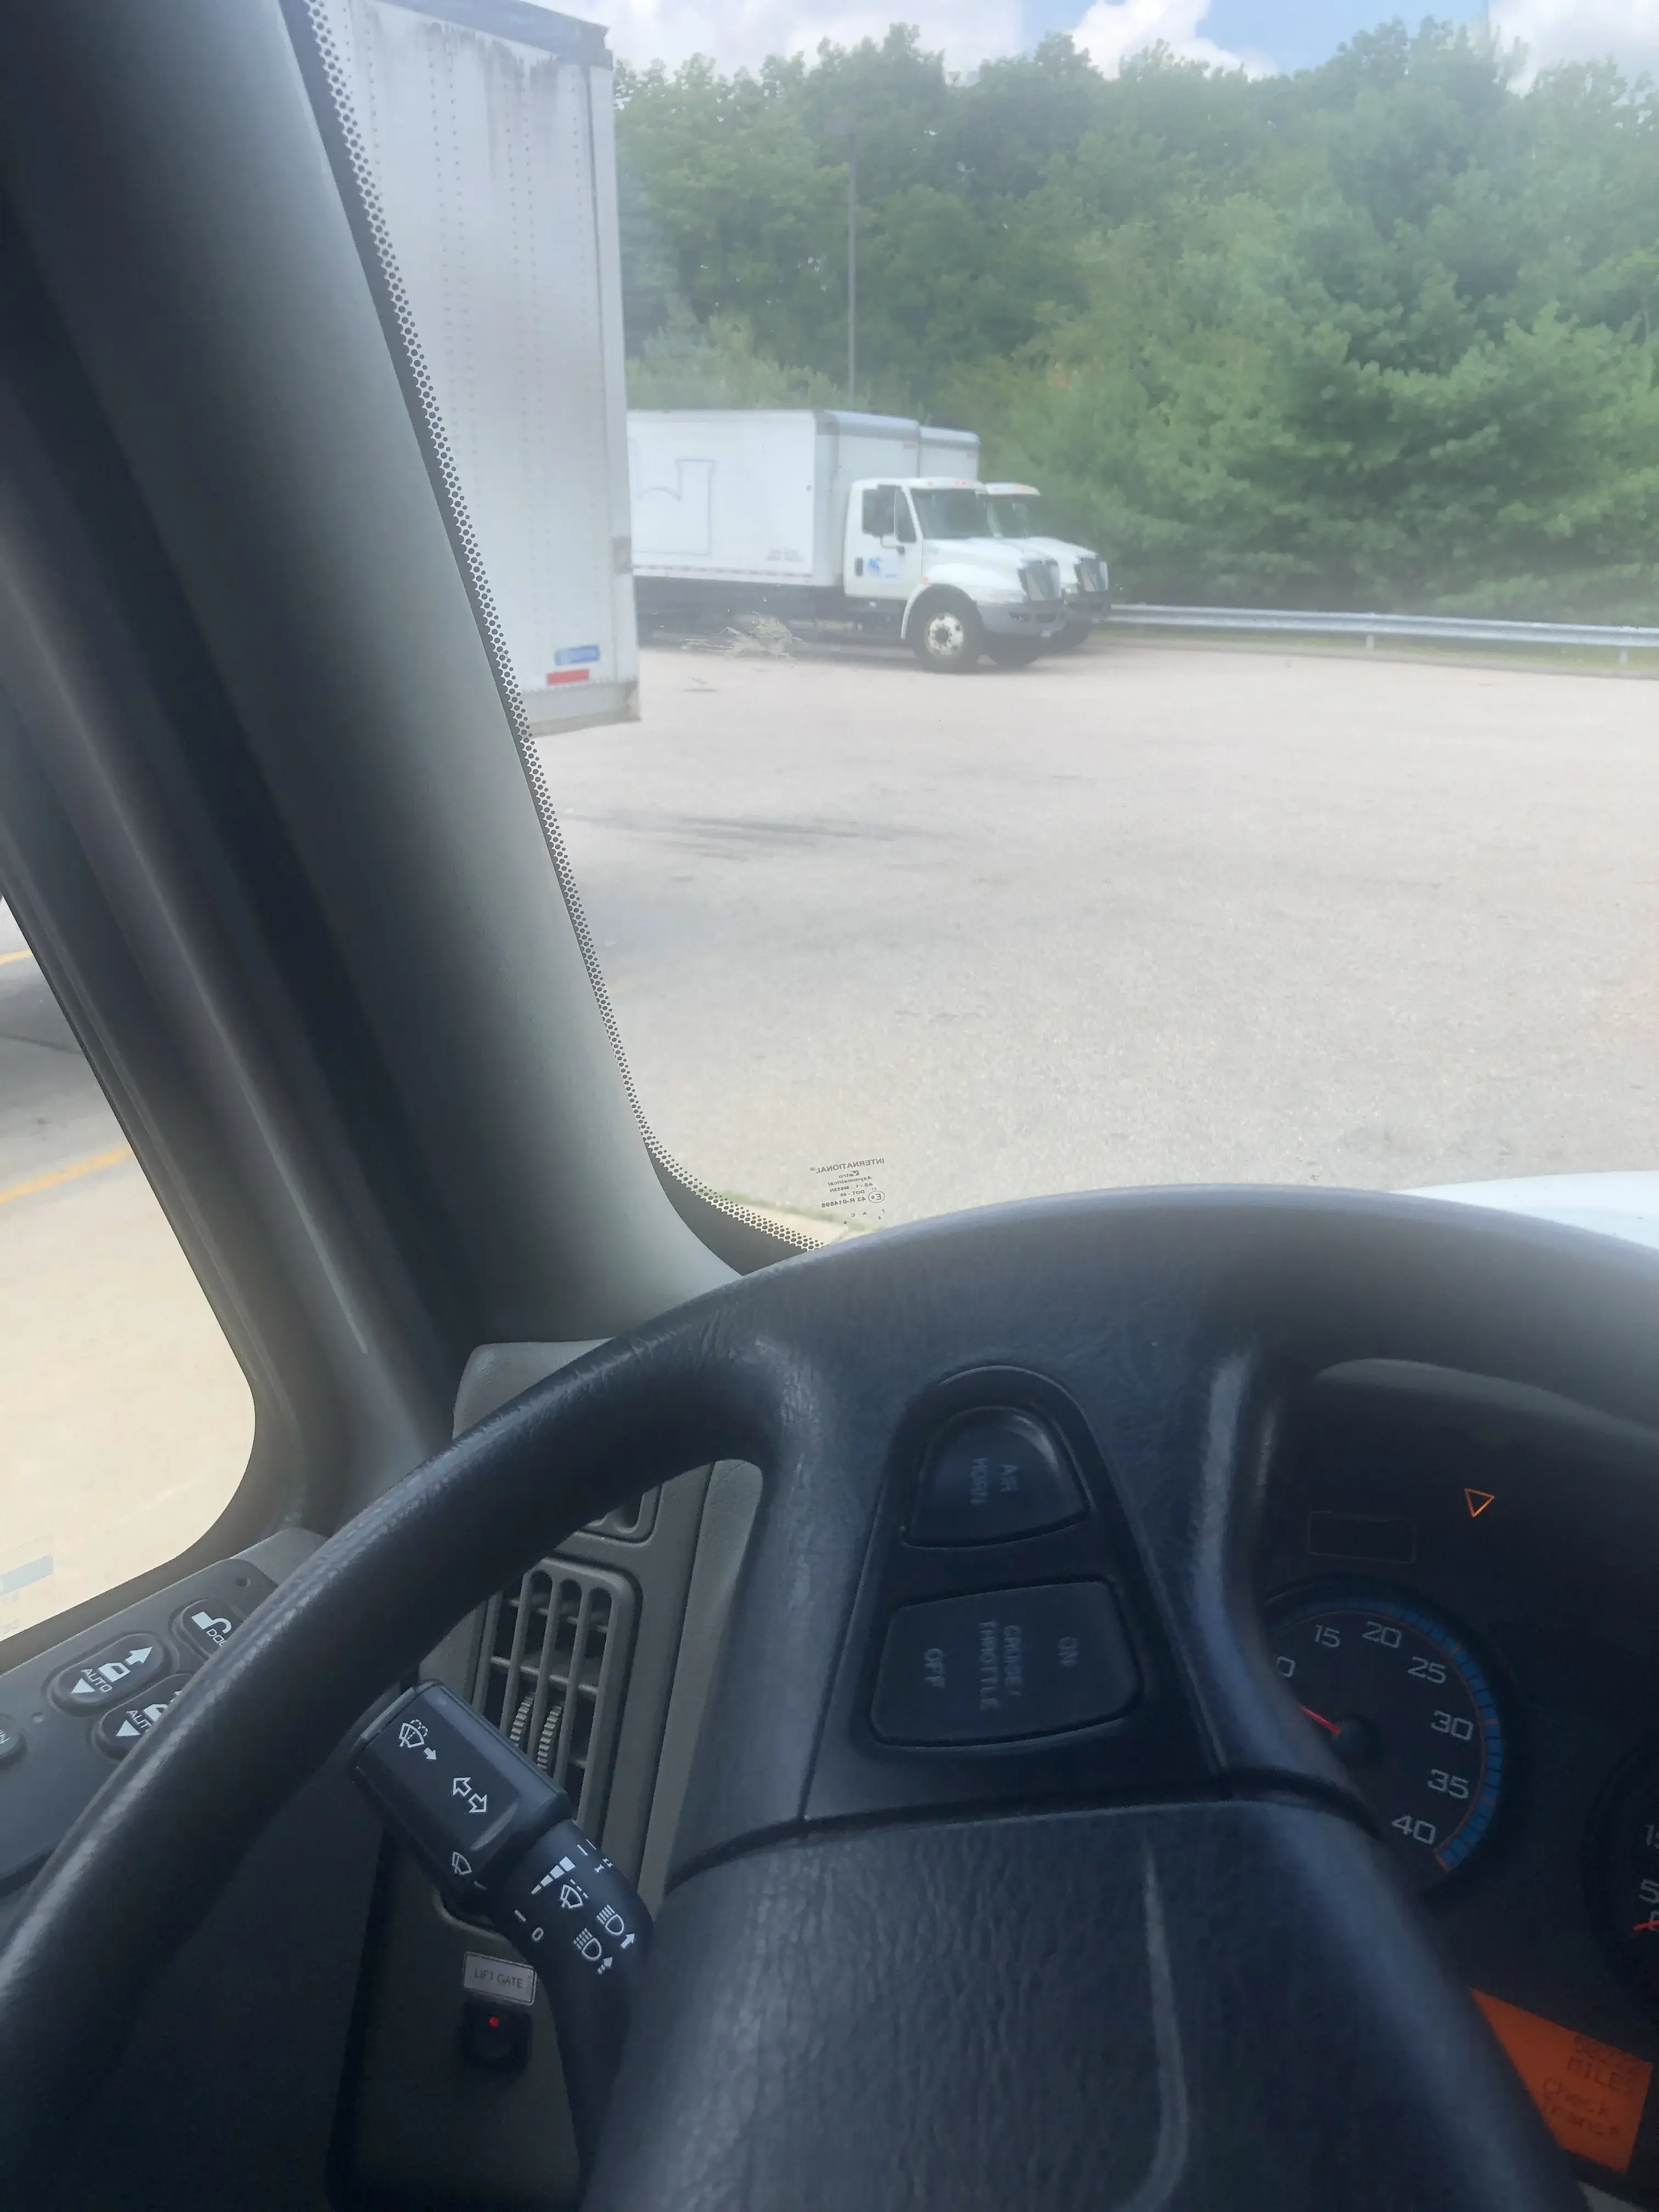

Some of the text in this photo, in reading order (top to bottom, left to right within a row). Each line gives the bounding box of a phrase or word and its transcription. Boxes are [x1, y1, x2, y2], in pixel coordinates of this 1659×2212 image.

[969, 1457, 989, 1505] HORN
[998, 1464, 1019, 1493] AIR
[1315, 1624, 1341, 1648] 15
[1362, 1621, 1403, 1649] 20
[979, 1621, 1000, 1711] THROTTLE
[1058, 1637, 1079, 1667] ON
[1276, 1655, 1296, 1678] 0
[80, 1668, 113, 1694] AUTO
[924, 1647, 946, 1689] OFF
[1407, 1656, 1447, 1684] 25
[126, 1709, 153, 1730] AUT
[1430, 1710, 1474, 1741] 30
[1427, 1768, 1470, 1799] 35
[1391, 1814, 1437, 1845] 40
[473, 1967, 524, 1989] LIFT GATE
